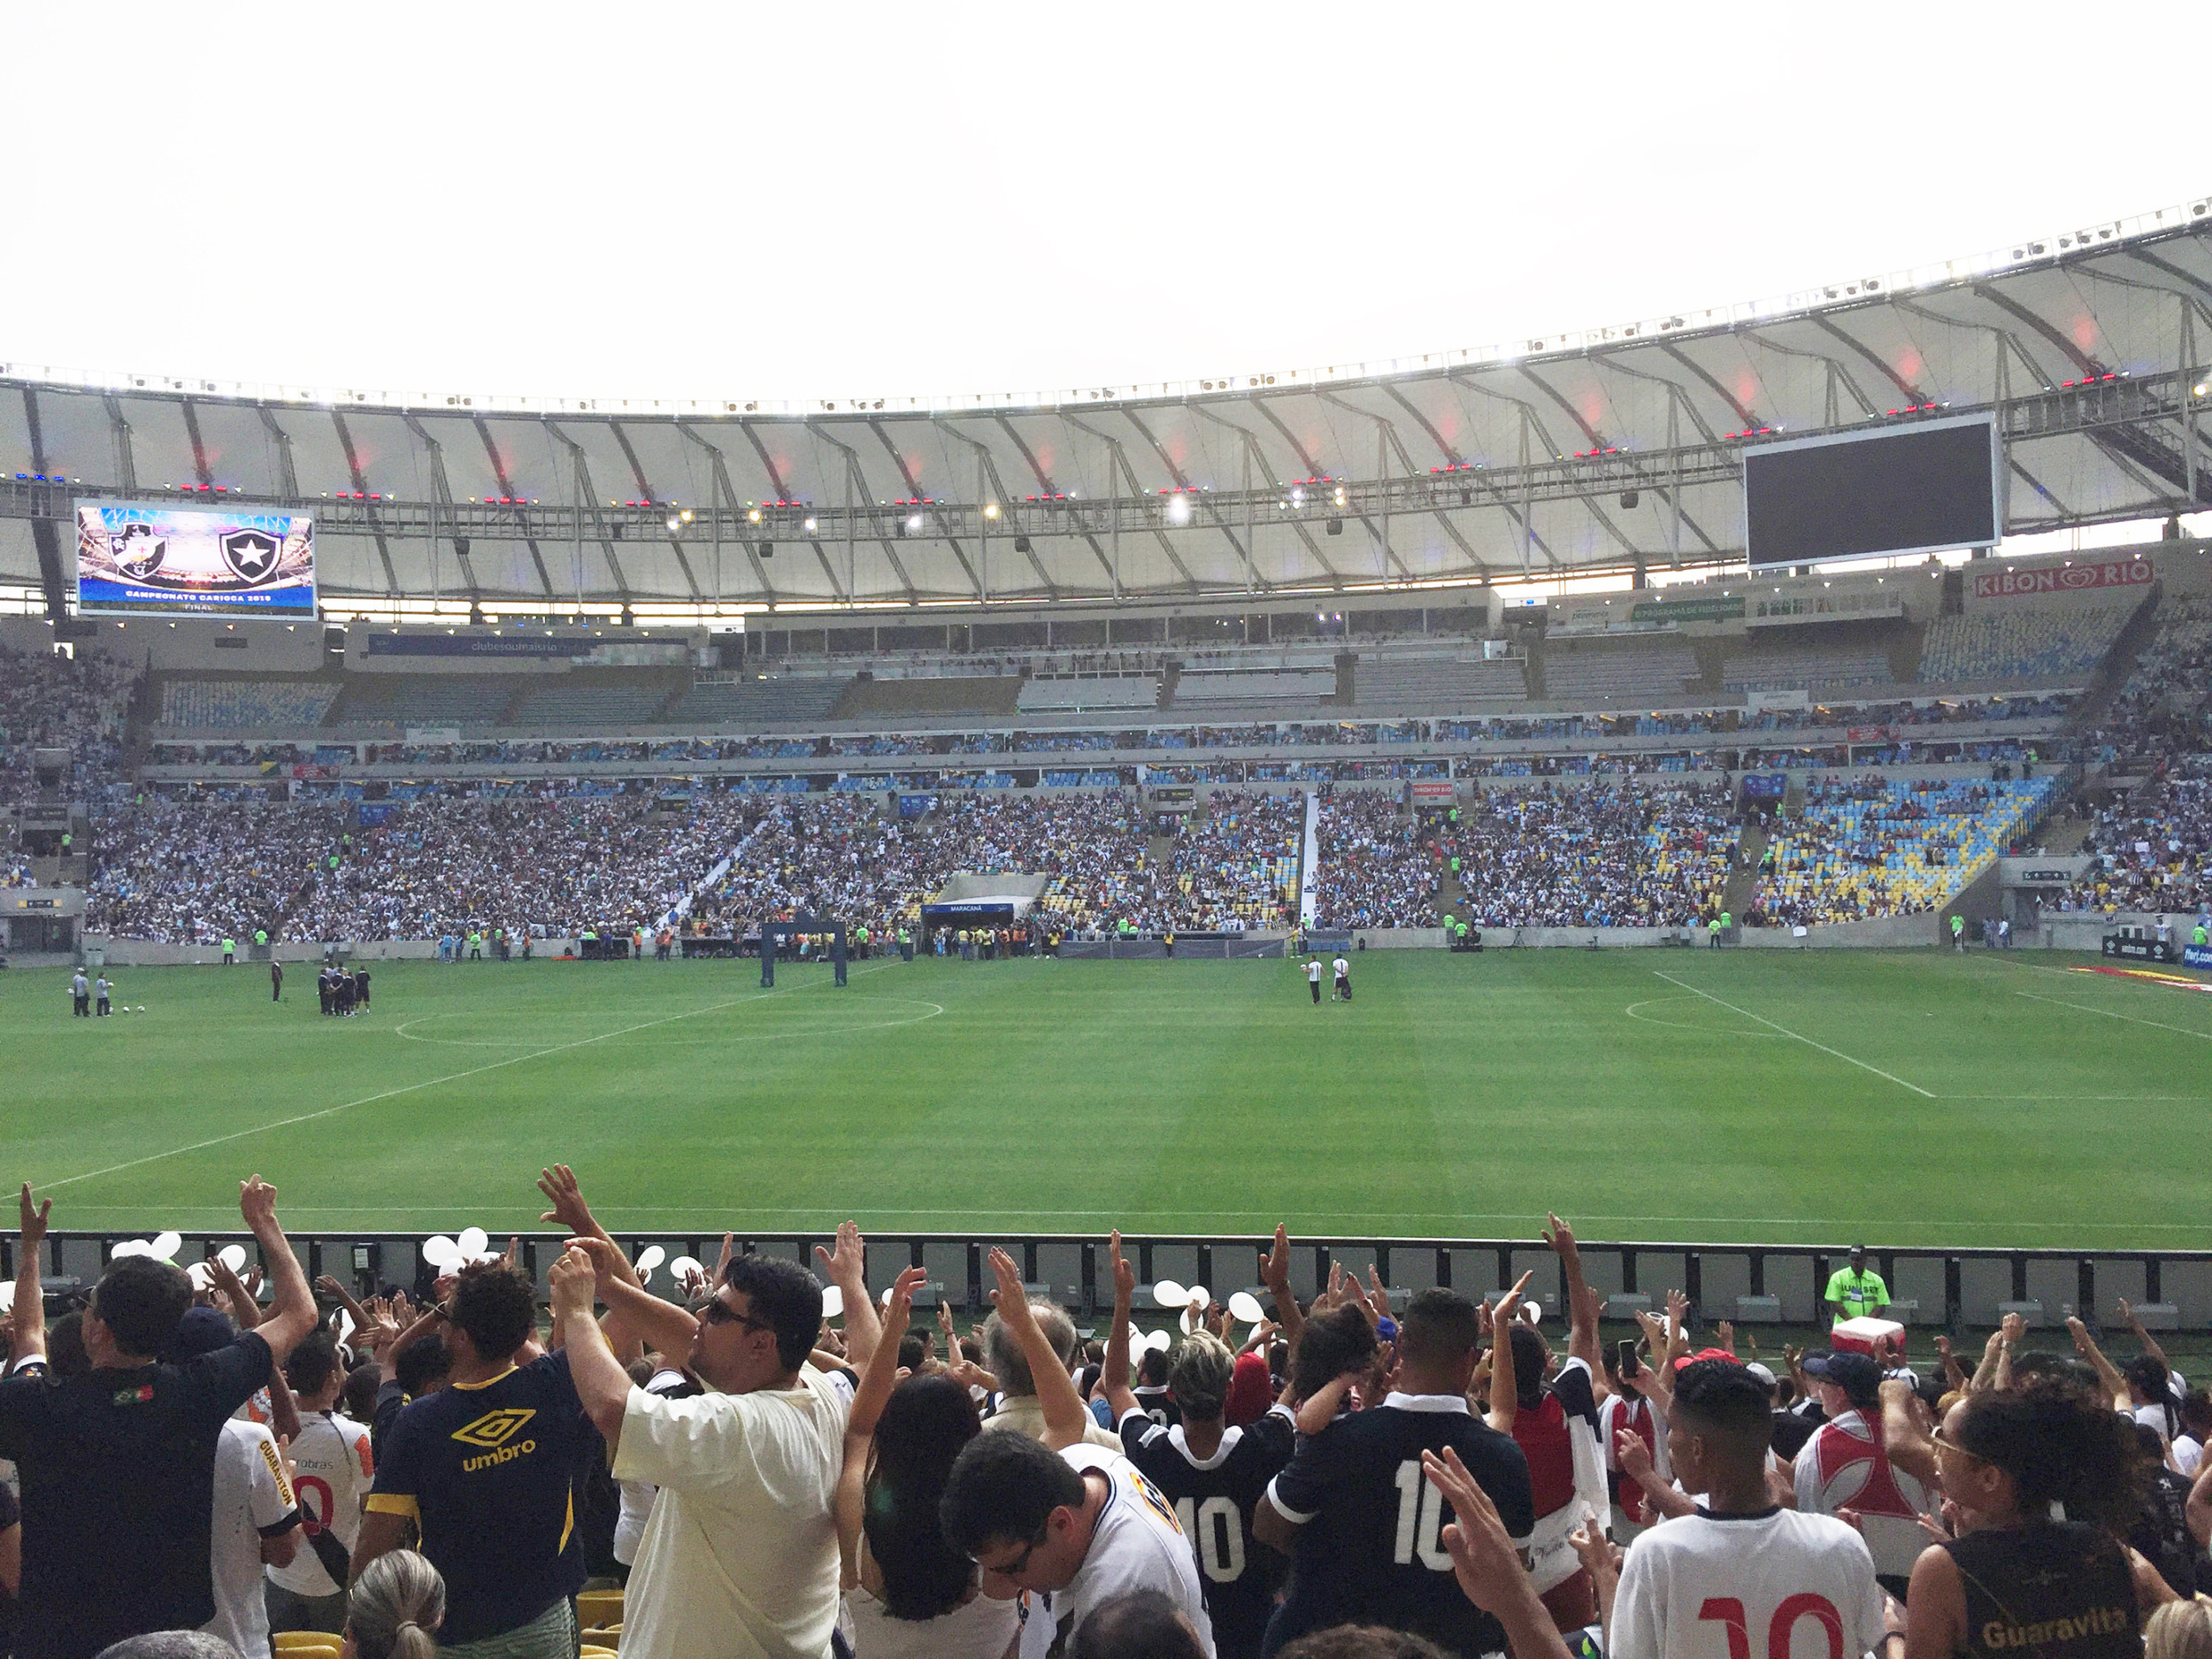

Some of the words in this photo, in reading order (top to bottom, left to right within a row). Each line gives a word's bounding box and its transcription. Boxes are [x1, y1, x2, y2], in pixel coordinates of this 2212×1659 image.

[125, 590, 196, 601] CAMPEONATO
[1978, 572, 2055, 595] KIBON
[2104, 561, 2150, 584] RIO
[258, 1439, 294, 1507] GUARAVITON
[296, 1458, 334, 1470] robras
[462, 1439, 536, 1472] umbro
[1174, 1496, 1246, 1583] 10
[1698, 1592, 1845, 1659] 10
[1982, 1606, 2127, 1649] Guaravita
